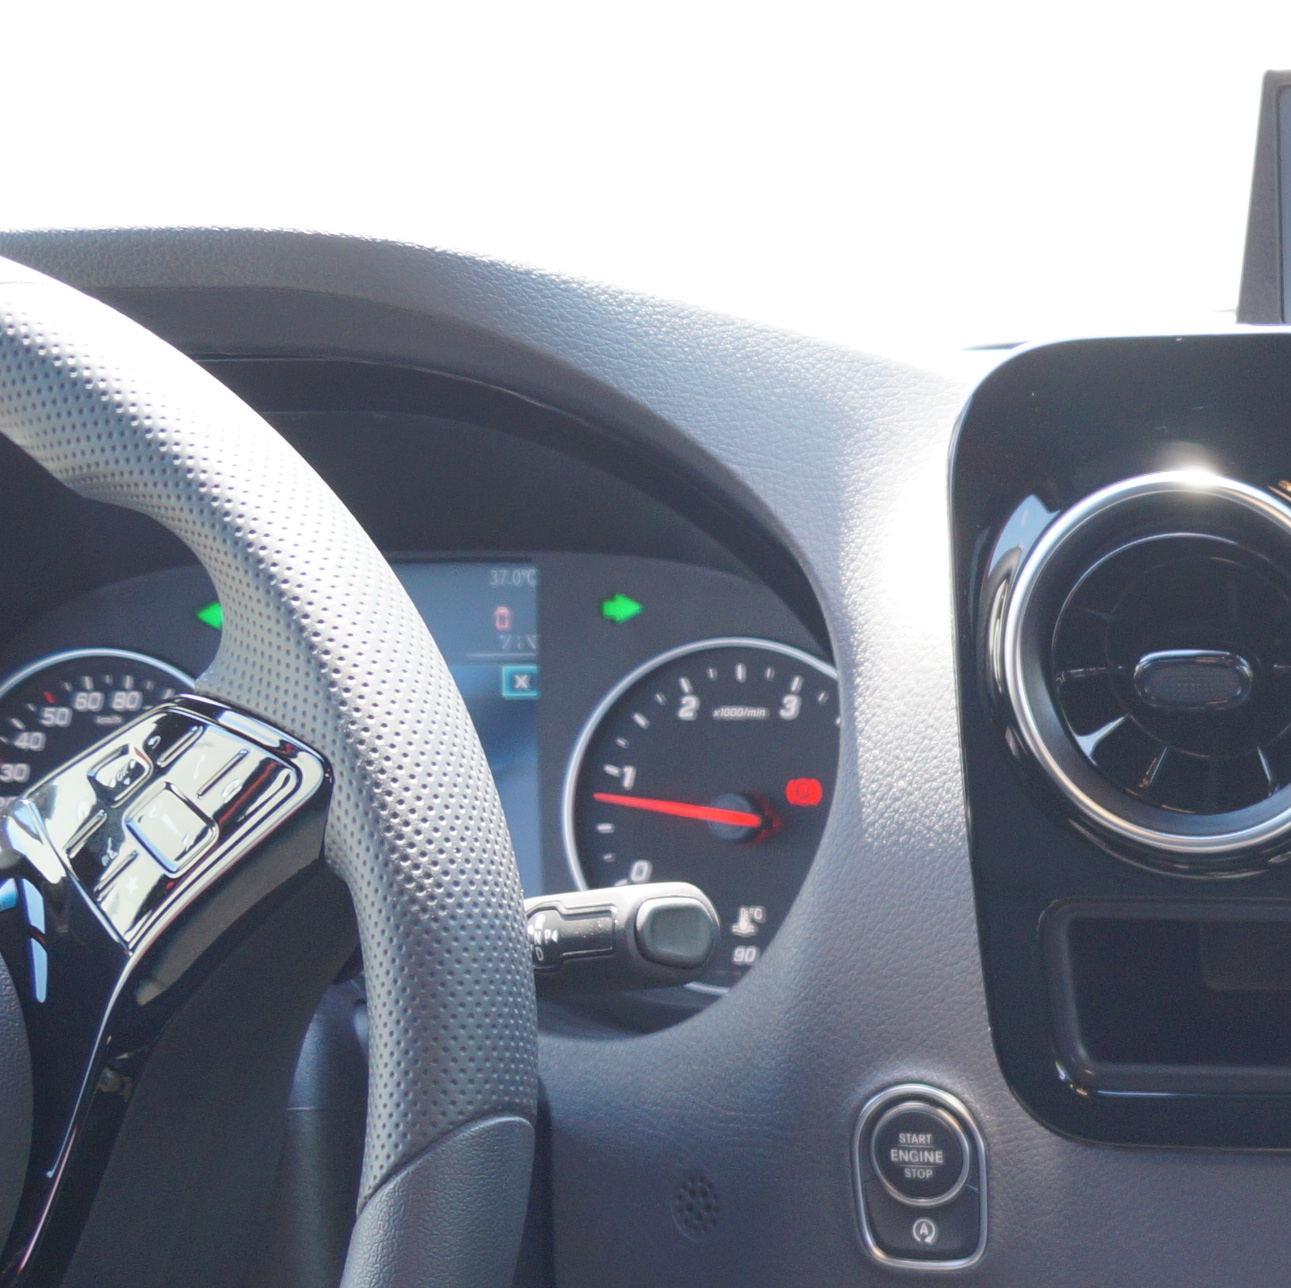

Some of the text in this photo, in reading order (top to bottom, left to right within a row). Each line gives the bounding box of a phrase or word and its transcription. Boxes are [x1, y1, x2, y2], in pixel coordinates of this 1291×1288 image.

[73, 691, 104, 711] 60
[112, 690, 142, 711] 80
[678, 694, 700, 721] 2
[779, 694, 801, 720] 3
[41, 706, 72, 727] 50
[712, 705, 769, 720] x1000/min
[14, 731, 46, 751] 40
[0, 762, 30, 783] 30
[622, 765, 637, 791] 1
[630, 859, 652, 884] 0
[731, 945, 757, 965] 90
[898, 1132, 933, 1145] START
[890, 1148, 944, 1165] ENGINE
[903, 1167, 934, 1179] STOP
